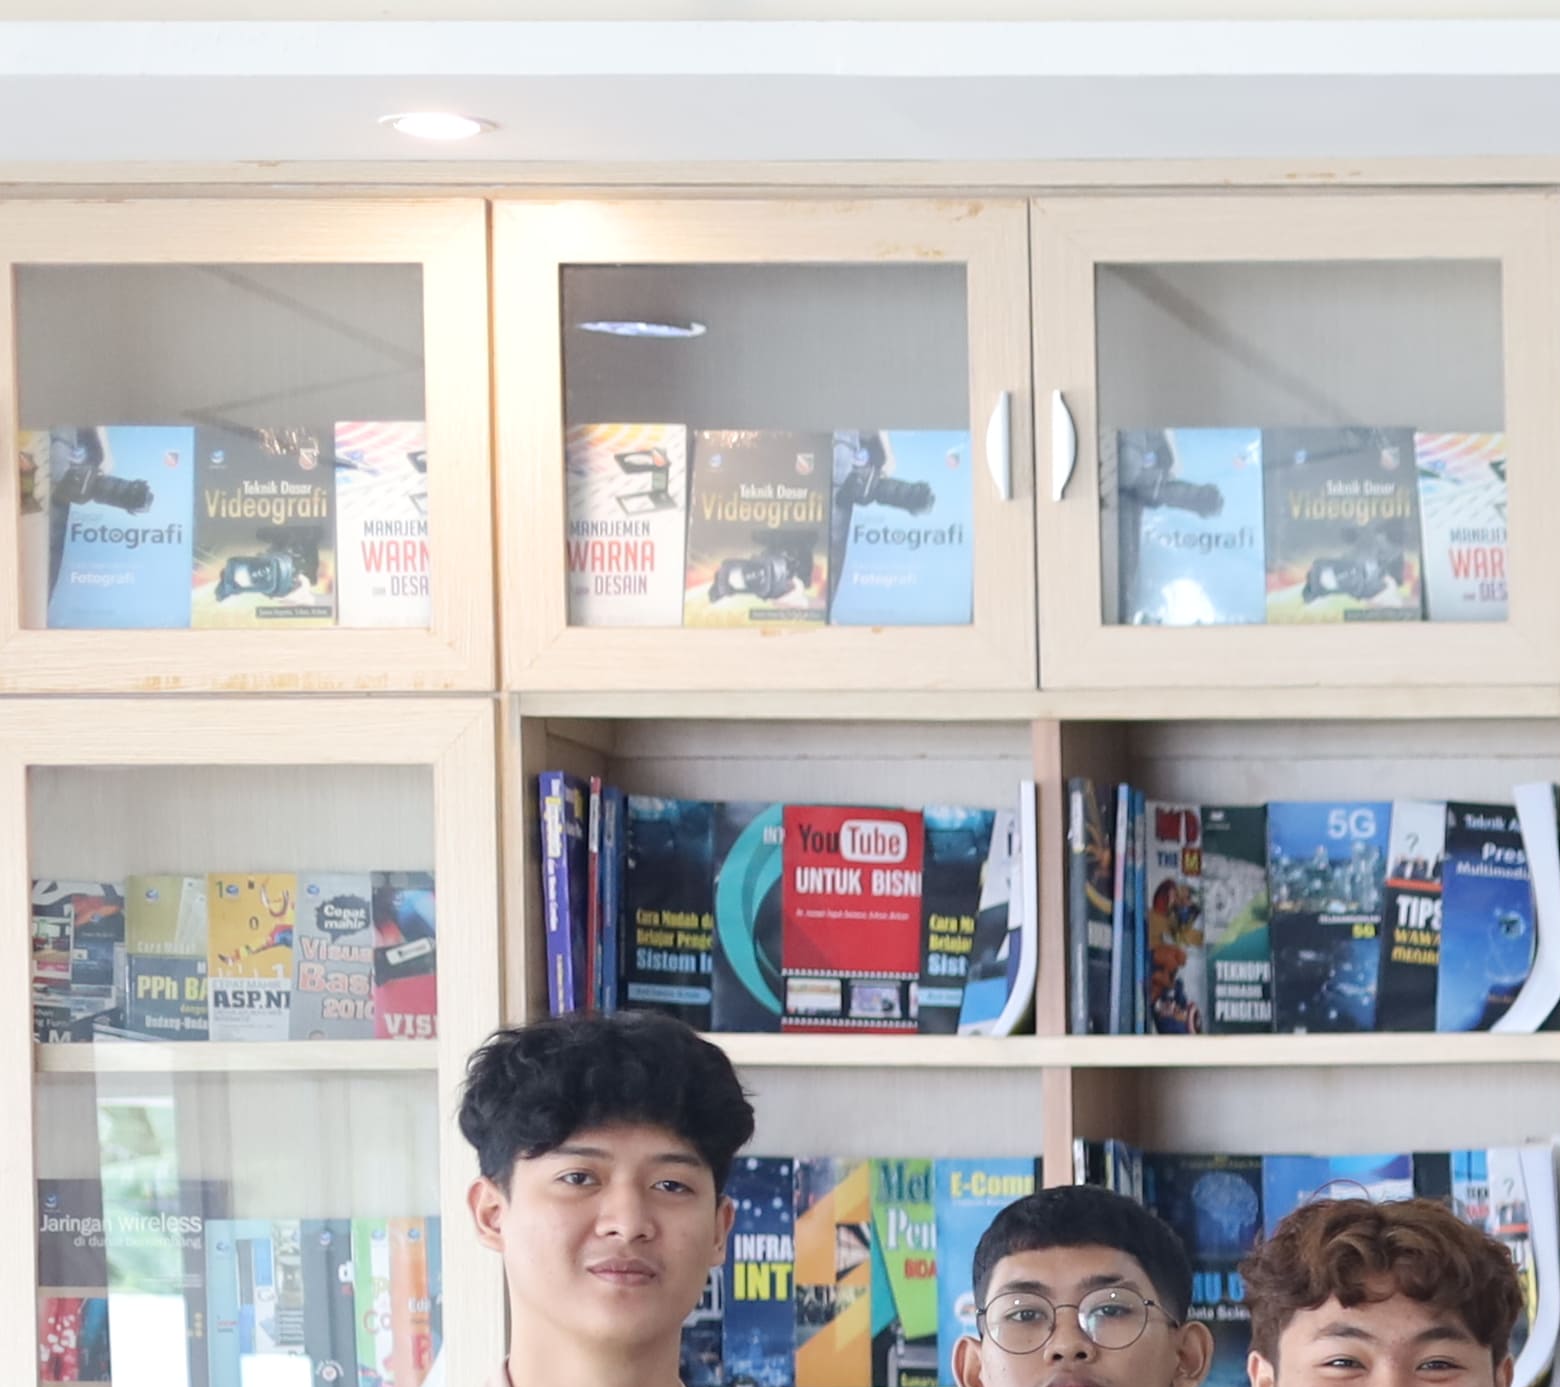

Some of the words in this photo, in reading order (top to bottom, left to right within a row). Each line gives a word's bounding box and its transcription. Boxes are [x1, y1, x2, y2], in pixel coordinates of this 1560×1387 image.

[243, 480, 278, 495] Teknik
[280, 481, 312, 495] Dasar
[740, 484, 775, 499] Teknik
[205, 489, 328, 525] Videografi
[703, 491, 825, 529] Videografi
[70, 523, 184, 550] Fotografi
[569, 520, 651, 537] MANAJEMEN
[852, 524, 964, 551] Fotografi
[567, 540, 656, 572] WARNA
[594, 575, 648, 595] DESAIN
[1328, 809, 1377, 839] 5G
[798, 822, 901, 856] YouTube
[795, 867, 863, 896] UNTUK
[637, 948, 697, 972] Sistem
[136, 975, 179, 1000] PPh
[39, 1212, 113, 1237] Jaringan
[119, 1212, 203, 1234] wireless
[734, 1234, 795, 1261] INFRA
